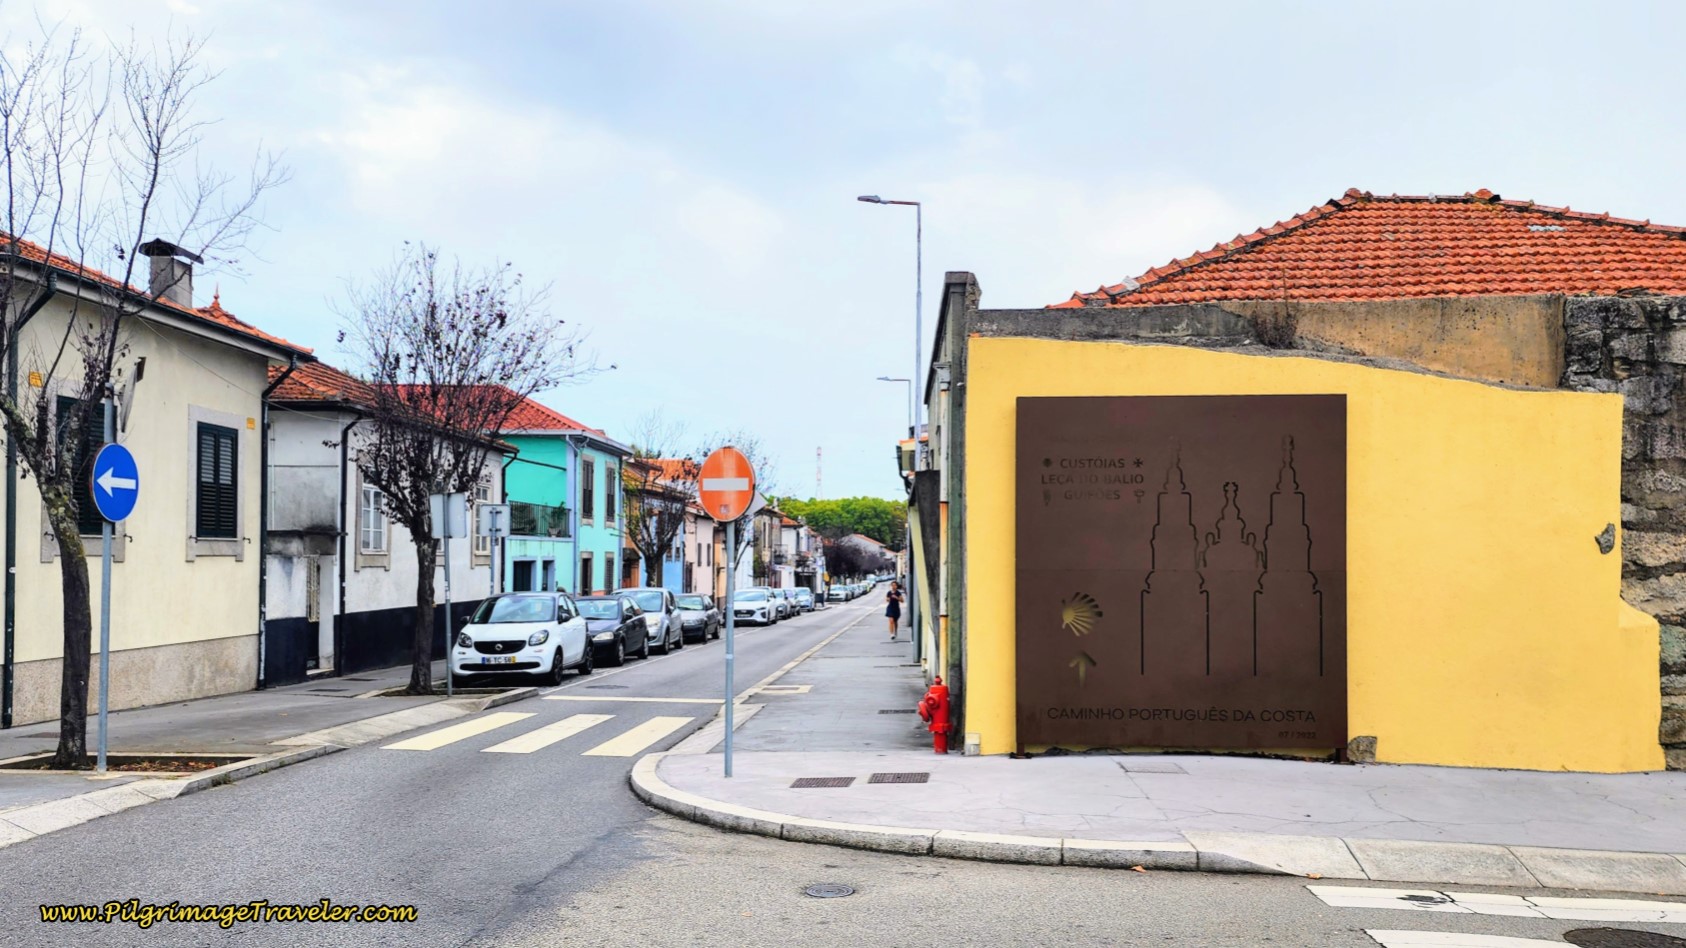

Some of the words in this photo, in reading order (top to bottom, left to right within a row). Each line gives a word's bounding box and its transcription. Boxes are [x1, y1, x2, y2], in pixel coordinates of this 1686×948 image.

[1059, 455, 1125, 469] CUSTÓIAS
[1041, 474, 1074, 485] LEÇA
[1047, 707, 1124, 720] CAMINHO
[1128, 706, 1229, 721] PORTUGUÊS
[1232, 709, 1256, 722] DA
[1260, 709, 1316, 722] COSTA
